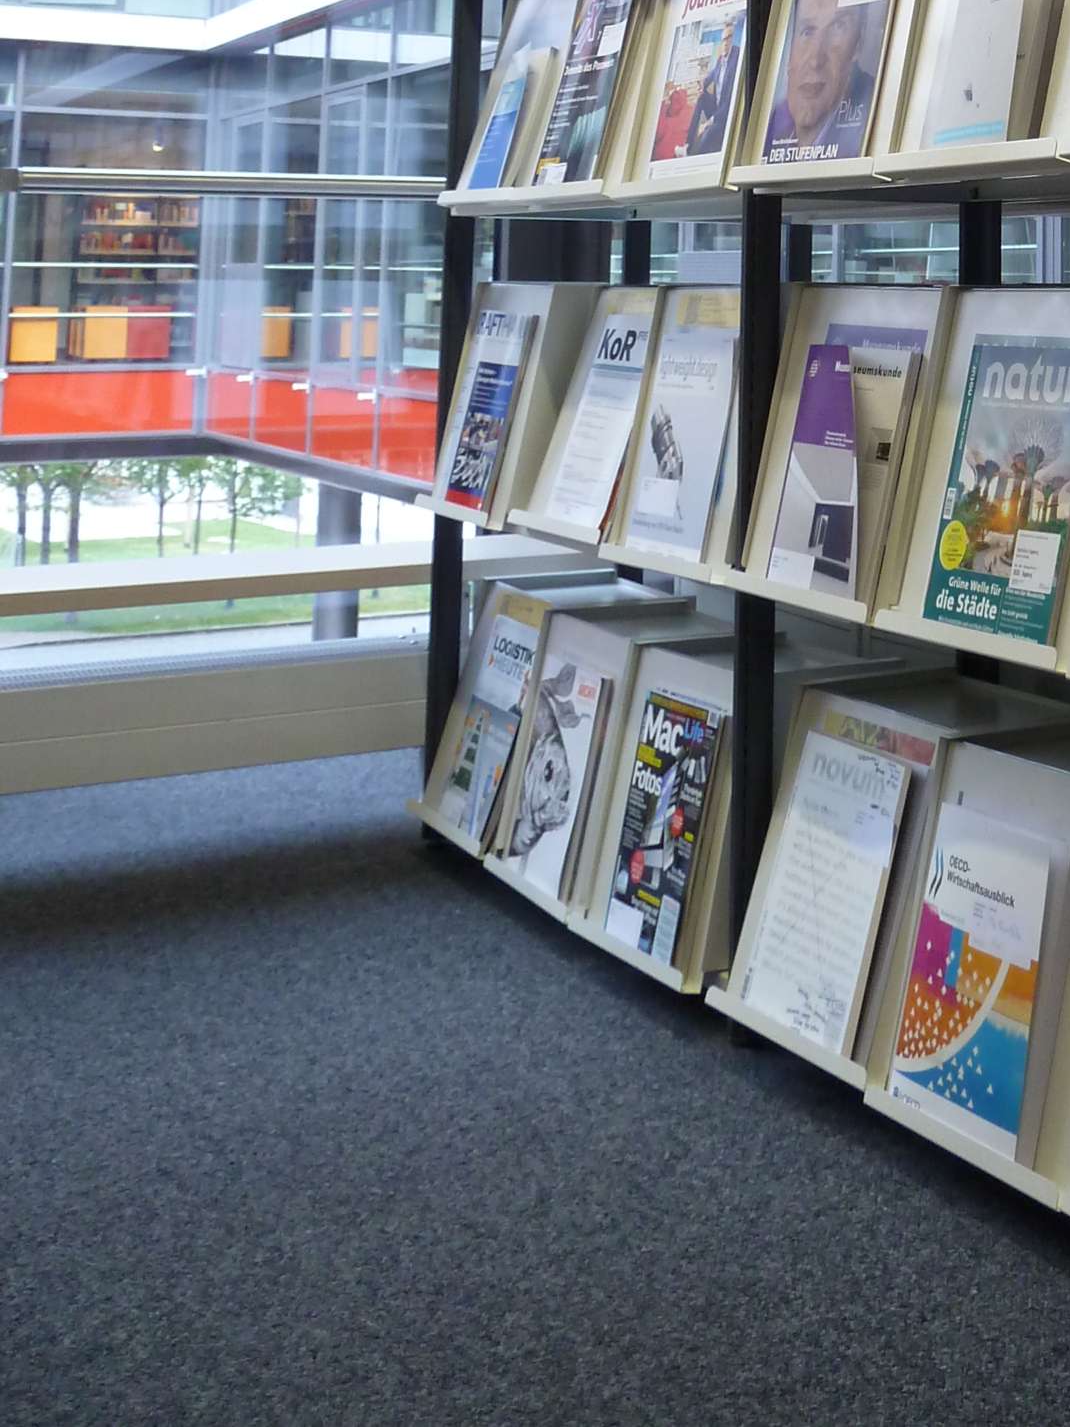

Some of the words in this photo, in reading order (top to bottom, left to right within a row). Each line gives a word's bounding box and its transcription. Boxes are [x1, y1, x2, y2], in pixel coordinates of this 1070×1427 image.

[769, 148, 786, 163] DER
[786, 143, 839, 161] STUFENPLAN
[597, 328, 638, 362] KoR
[948, 575, 969, 591] Grüne
[969, 579, 990, 594] Welle
[990, 583, 1002, 596] für
[935, 588, 955, 611] die
[955, 592, 998, 621] Städte
[643, 704, 684, 756] Mac
[632, 760, 663, 796] Fotos
[812, 755, 886, 799] novum
[949, 855, 971, 873] OECD-
[946, 870, 1015, 909] Wirtschaftsausblick
